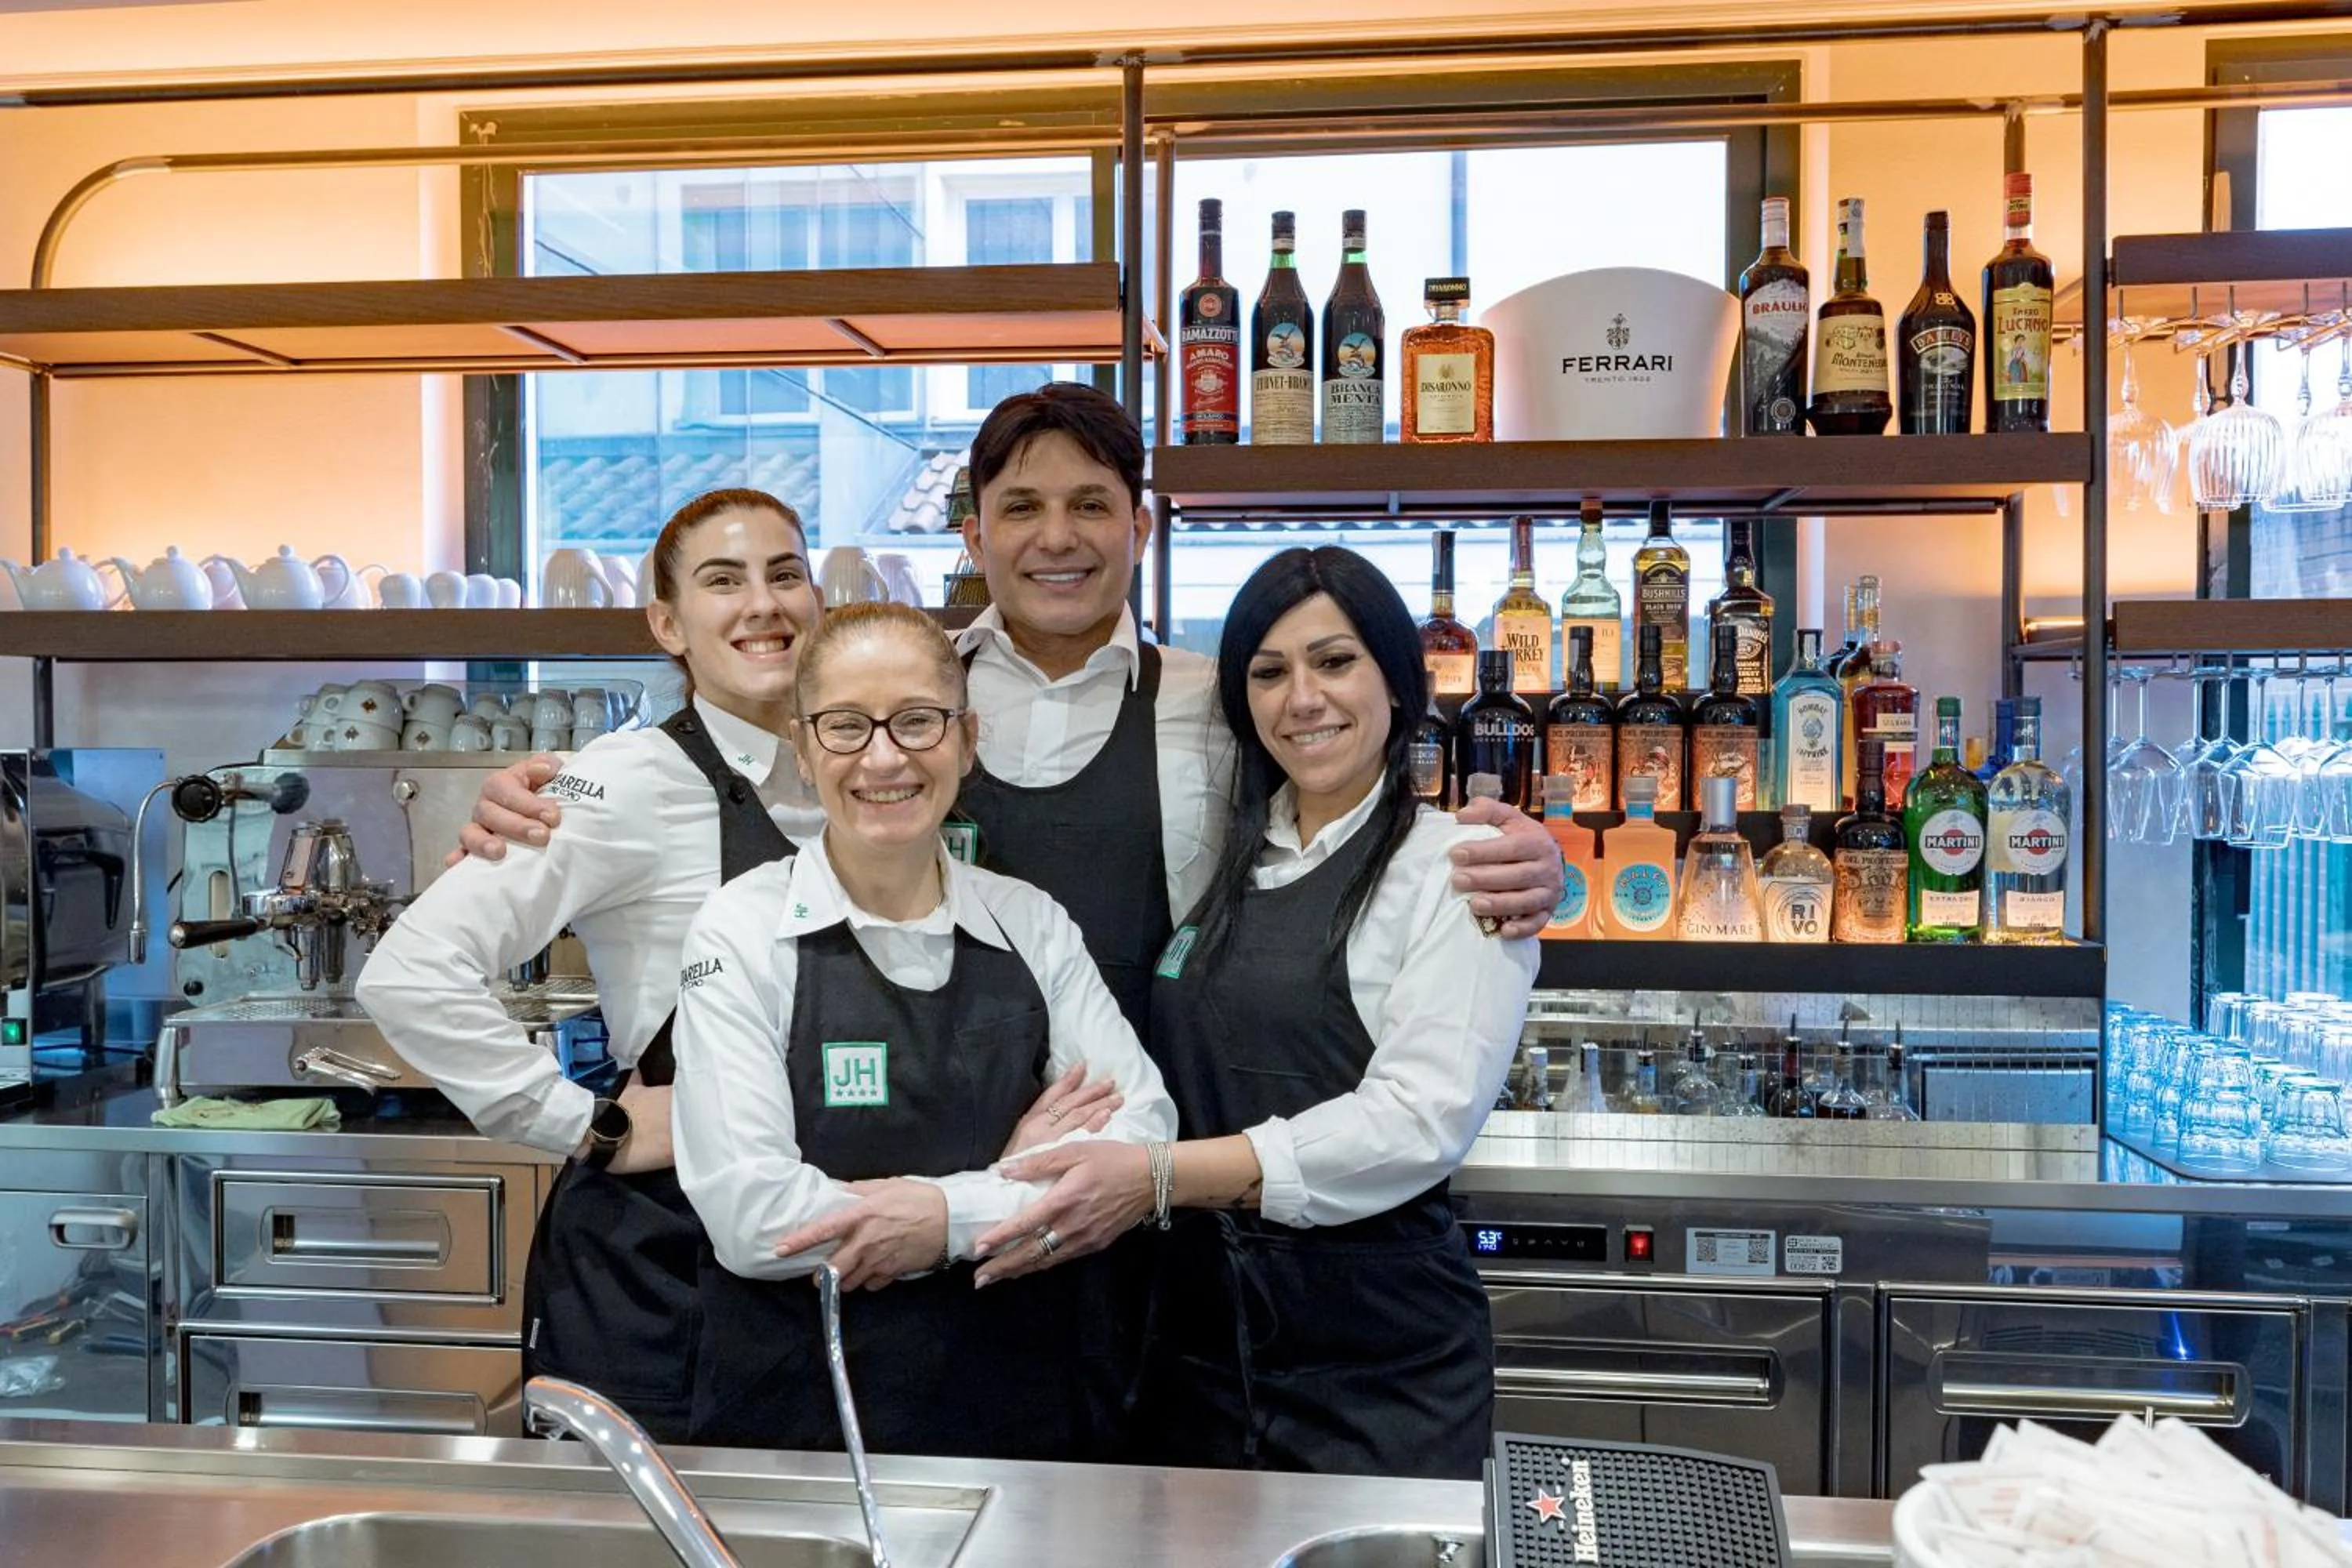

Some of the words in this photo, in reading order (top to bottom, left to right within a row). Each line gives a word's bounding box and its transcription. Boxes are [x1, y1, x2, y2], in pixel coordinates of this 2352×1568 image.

[1562, 355, 1673, 373] FERRARI
[1421, 382, 1471, 393] DISARONNO
[1331, 394, 1381, 404] MENTA
[1506, 633, 1539, 648] WILD
[1926, 837, 1980, 848] MARTINI
[2010, 837, 2063, 848] MARTINI
[1686, 923, 1711, 935] GIN
[1716, 924, 1753, 935] MARE
[833, 1058, 877, 1087] JH
[1570, 1460, 1599, 1563] Heineken
